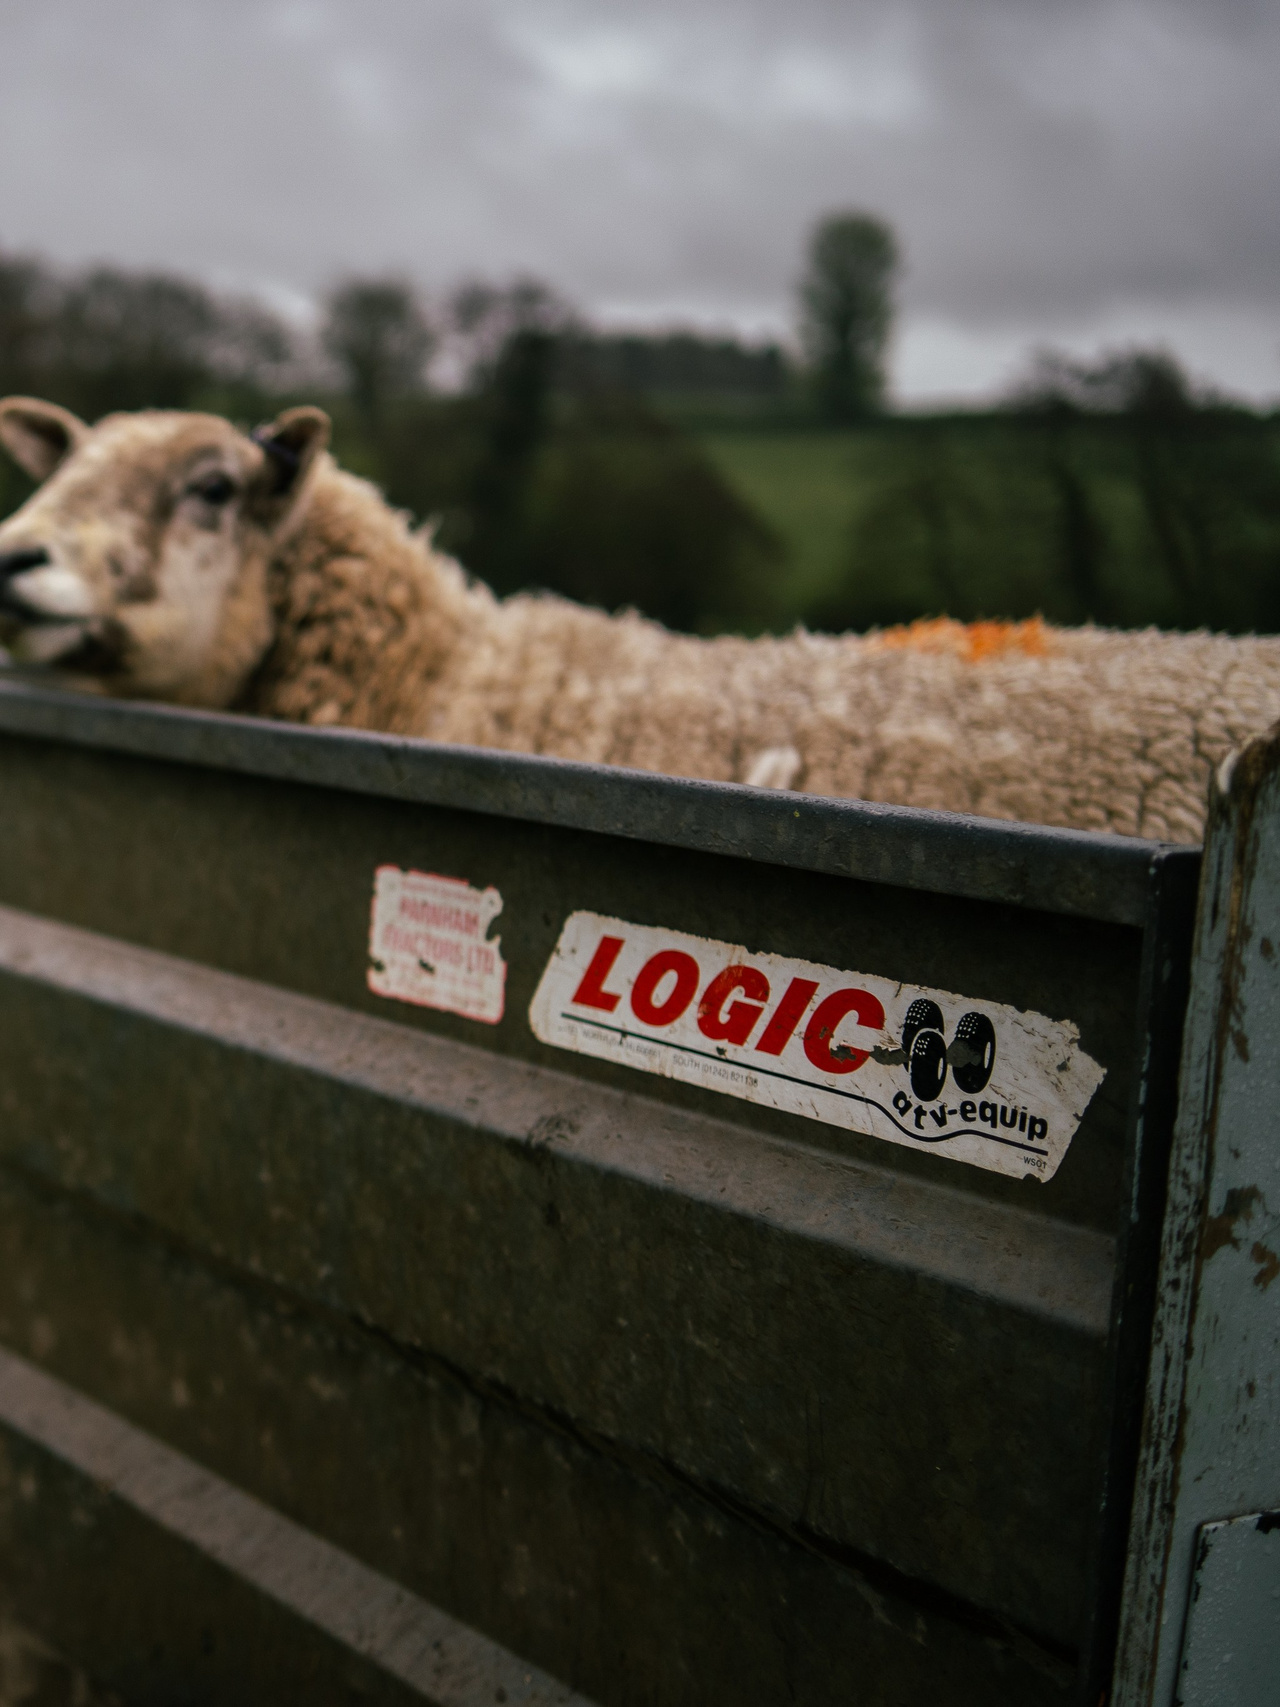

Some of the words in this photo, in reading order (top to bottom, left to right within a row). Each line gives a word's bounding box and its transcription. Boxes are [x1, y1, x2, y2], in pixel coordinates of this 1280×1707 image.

[572, 936, 885, 1074] LOGIC
[672, 1053, 700, 1069] SOUTH
[892, 1090, 1048, 1140] atv-equip
